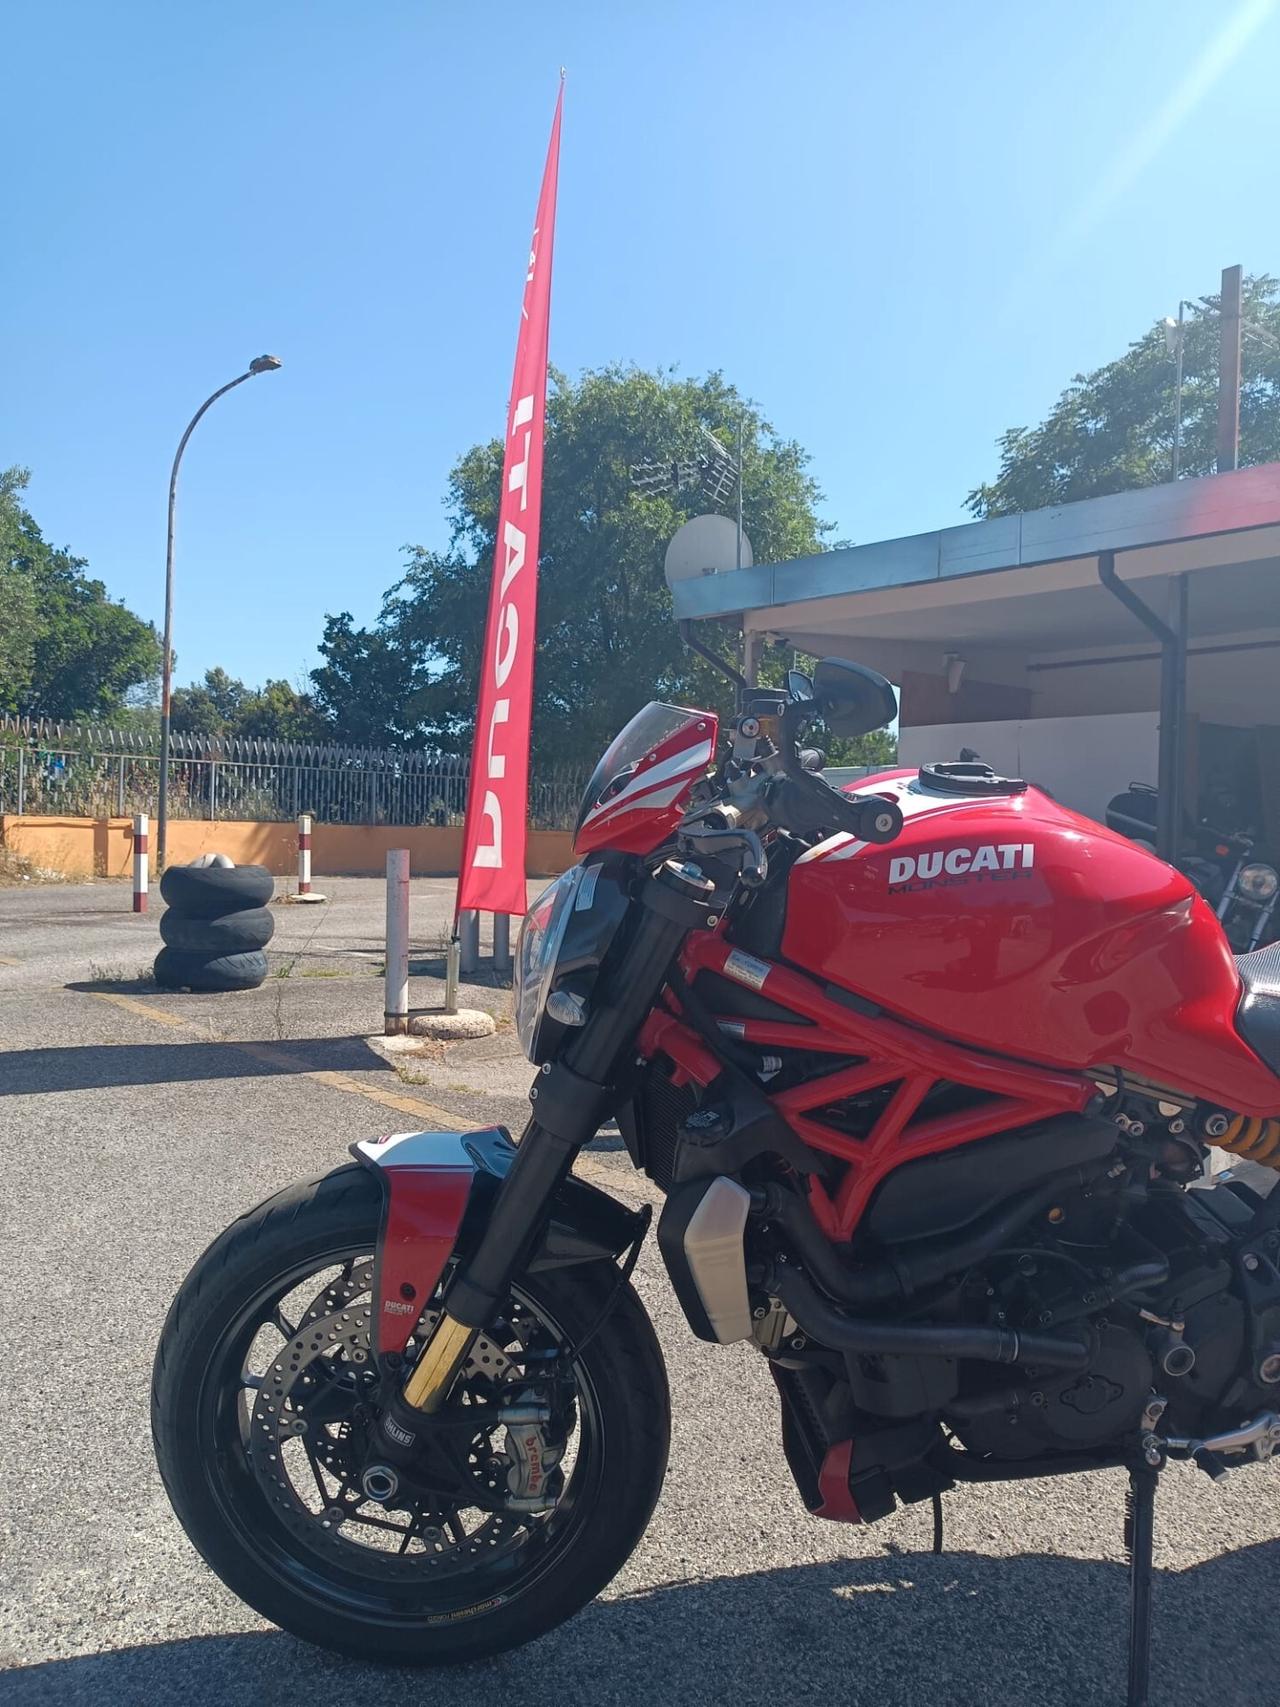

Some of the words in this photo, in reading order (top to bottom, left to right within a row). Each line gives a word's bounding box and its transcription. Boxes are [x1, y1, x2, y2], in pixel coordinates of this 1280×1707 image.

[888, 843, 1035, 885] DUCATI
[384, 1300, 415, 1314] DUCATI
[526, 1436, 543, 1491] brembo
